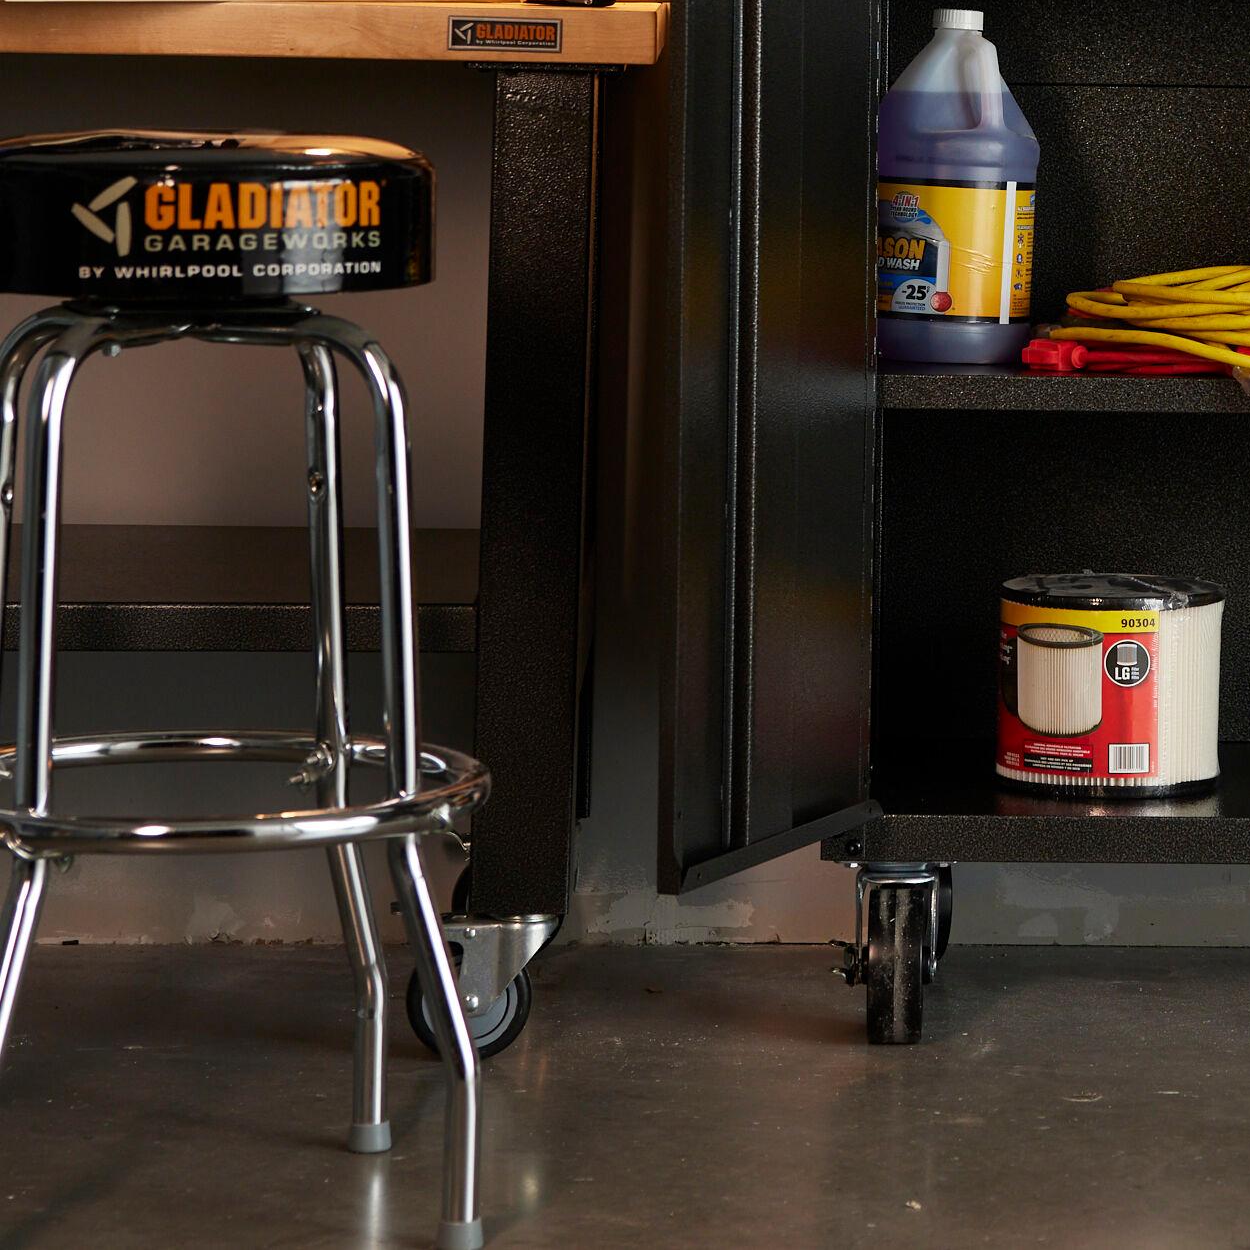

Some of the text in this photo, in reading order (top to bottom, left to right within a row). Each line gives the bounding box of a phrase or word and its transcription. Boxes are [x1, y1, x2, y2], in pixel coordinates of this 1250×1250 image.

[475, 23, 556, 41] GLADIATOR
[144, 180, 381, 231] GLADIATOR
[144, 231, 381, 252] GARAGEWORKS
[79, 261, 382, 279] BY WHIRLPOOL CORPORATION
[887, 257, 920, 270] WASH
[1121, 618, 1156, 628] 90304
[1114, 666, 1130, 680] LG
